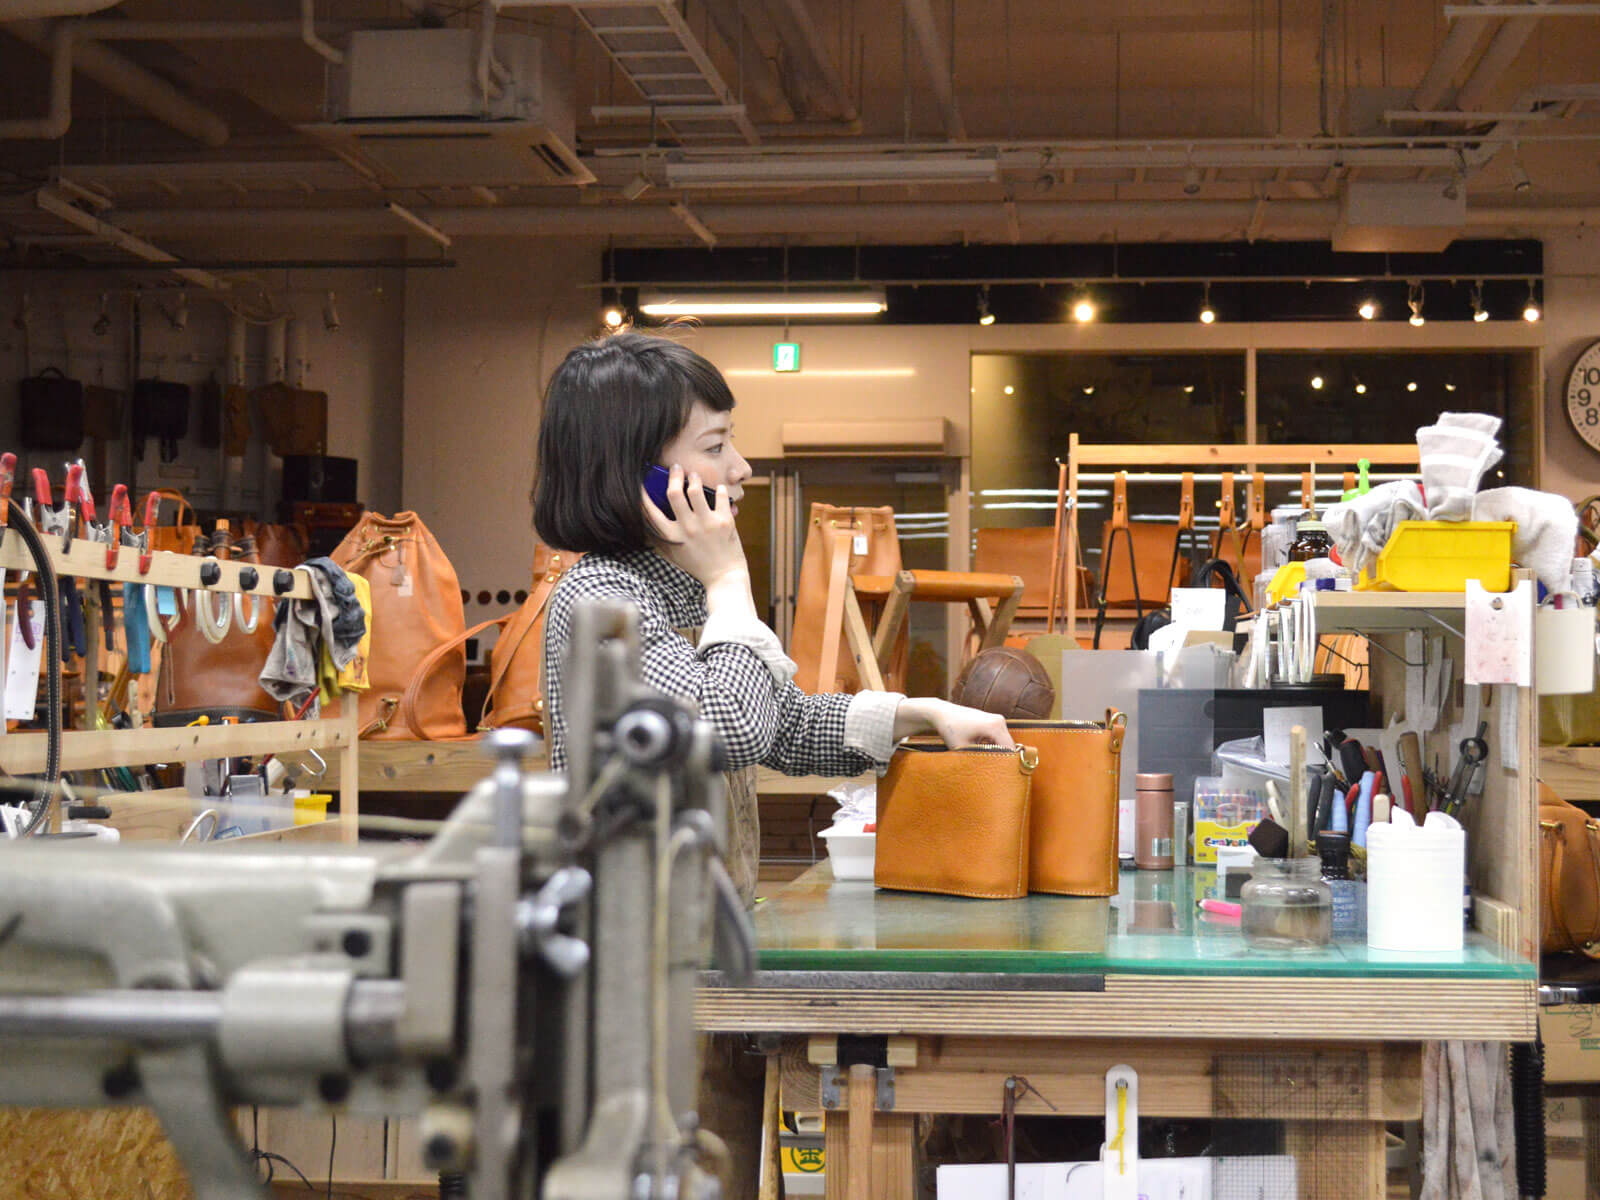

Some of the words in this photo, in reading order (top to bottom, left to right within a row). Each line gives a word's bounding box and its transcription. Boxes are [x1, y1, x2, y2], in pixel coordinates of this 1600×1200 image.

[1582, 367, 1600, 385] 10
[1577, 388, 1591, 407] 9
[1585, 408, 1599, 426] 8
